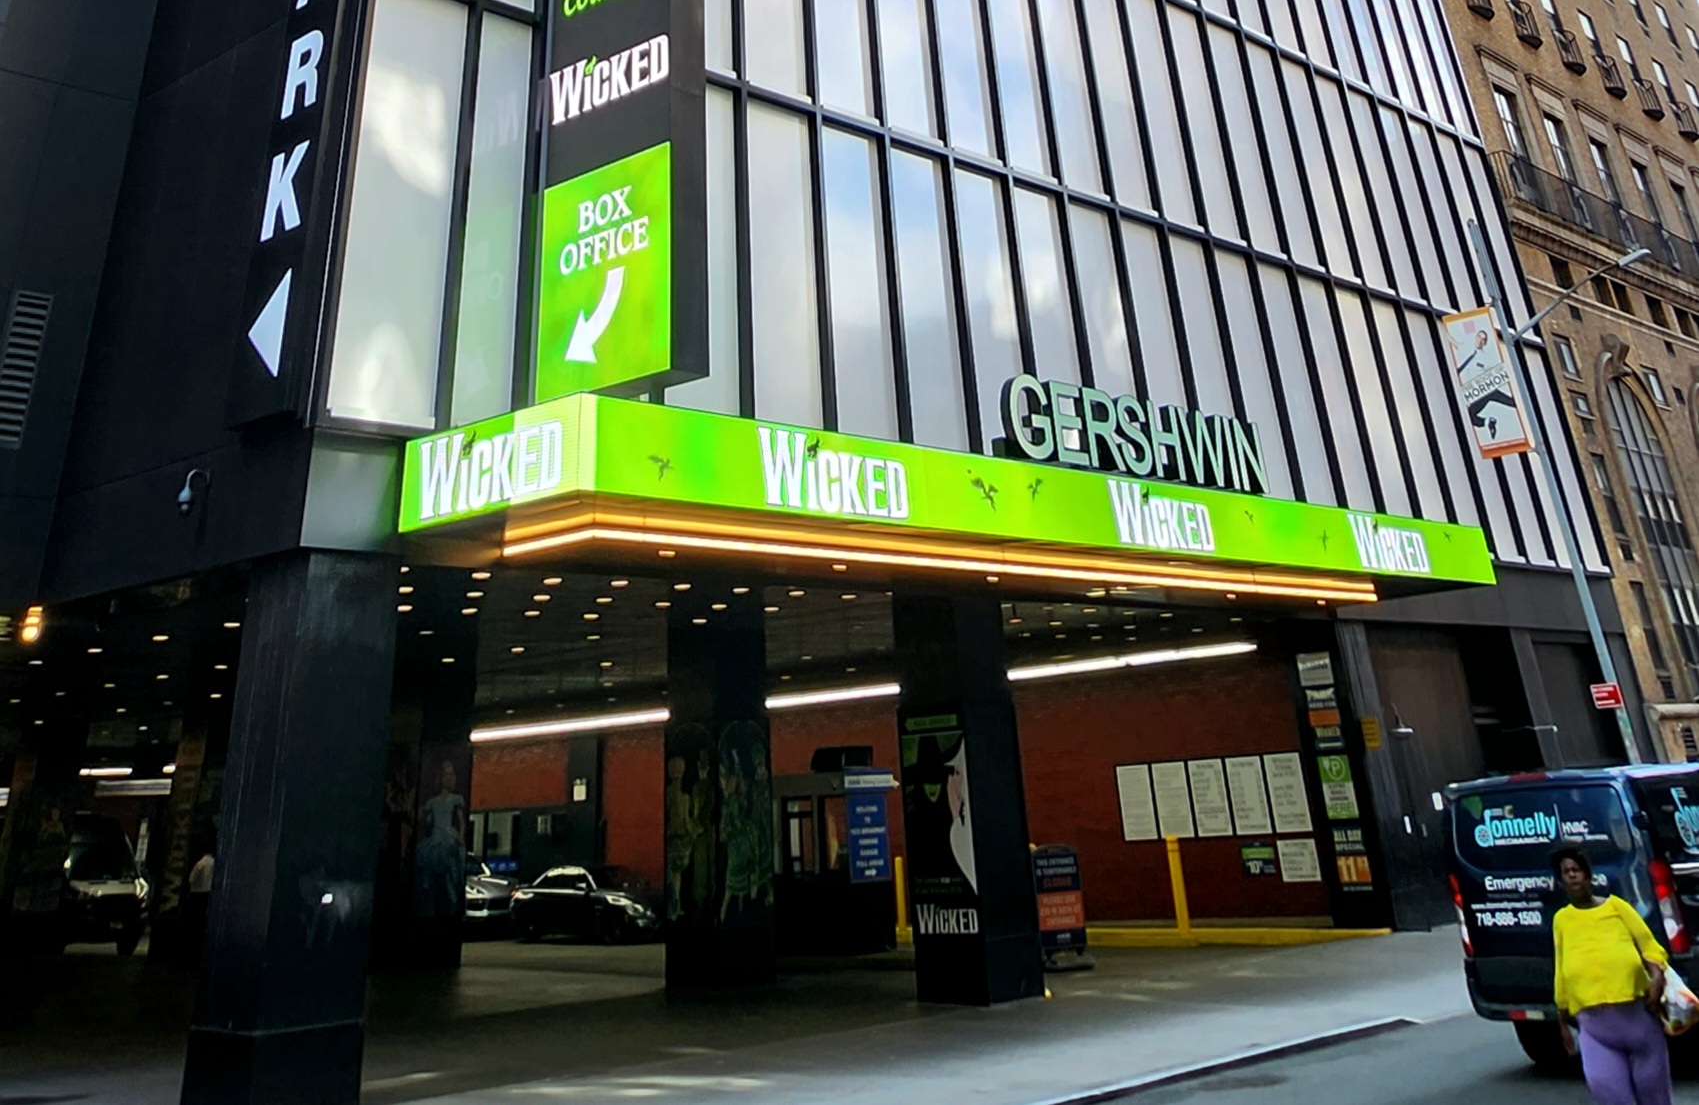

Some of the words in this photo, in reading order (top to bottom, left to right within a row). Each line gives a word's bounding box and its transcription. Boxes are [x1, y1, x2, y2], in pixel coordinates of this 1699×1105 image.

[578, 185, 632, 233] BOX
[560, 216, 649, 275] OFFICE
[1464, 371, 1509, 402] MORMON
[1003, 374, 1270, 494] GERSHWIN
[1474, 808, 1556, 847] donnelly
[1484, 876, 1554, 892] Emergency
